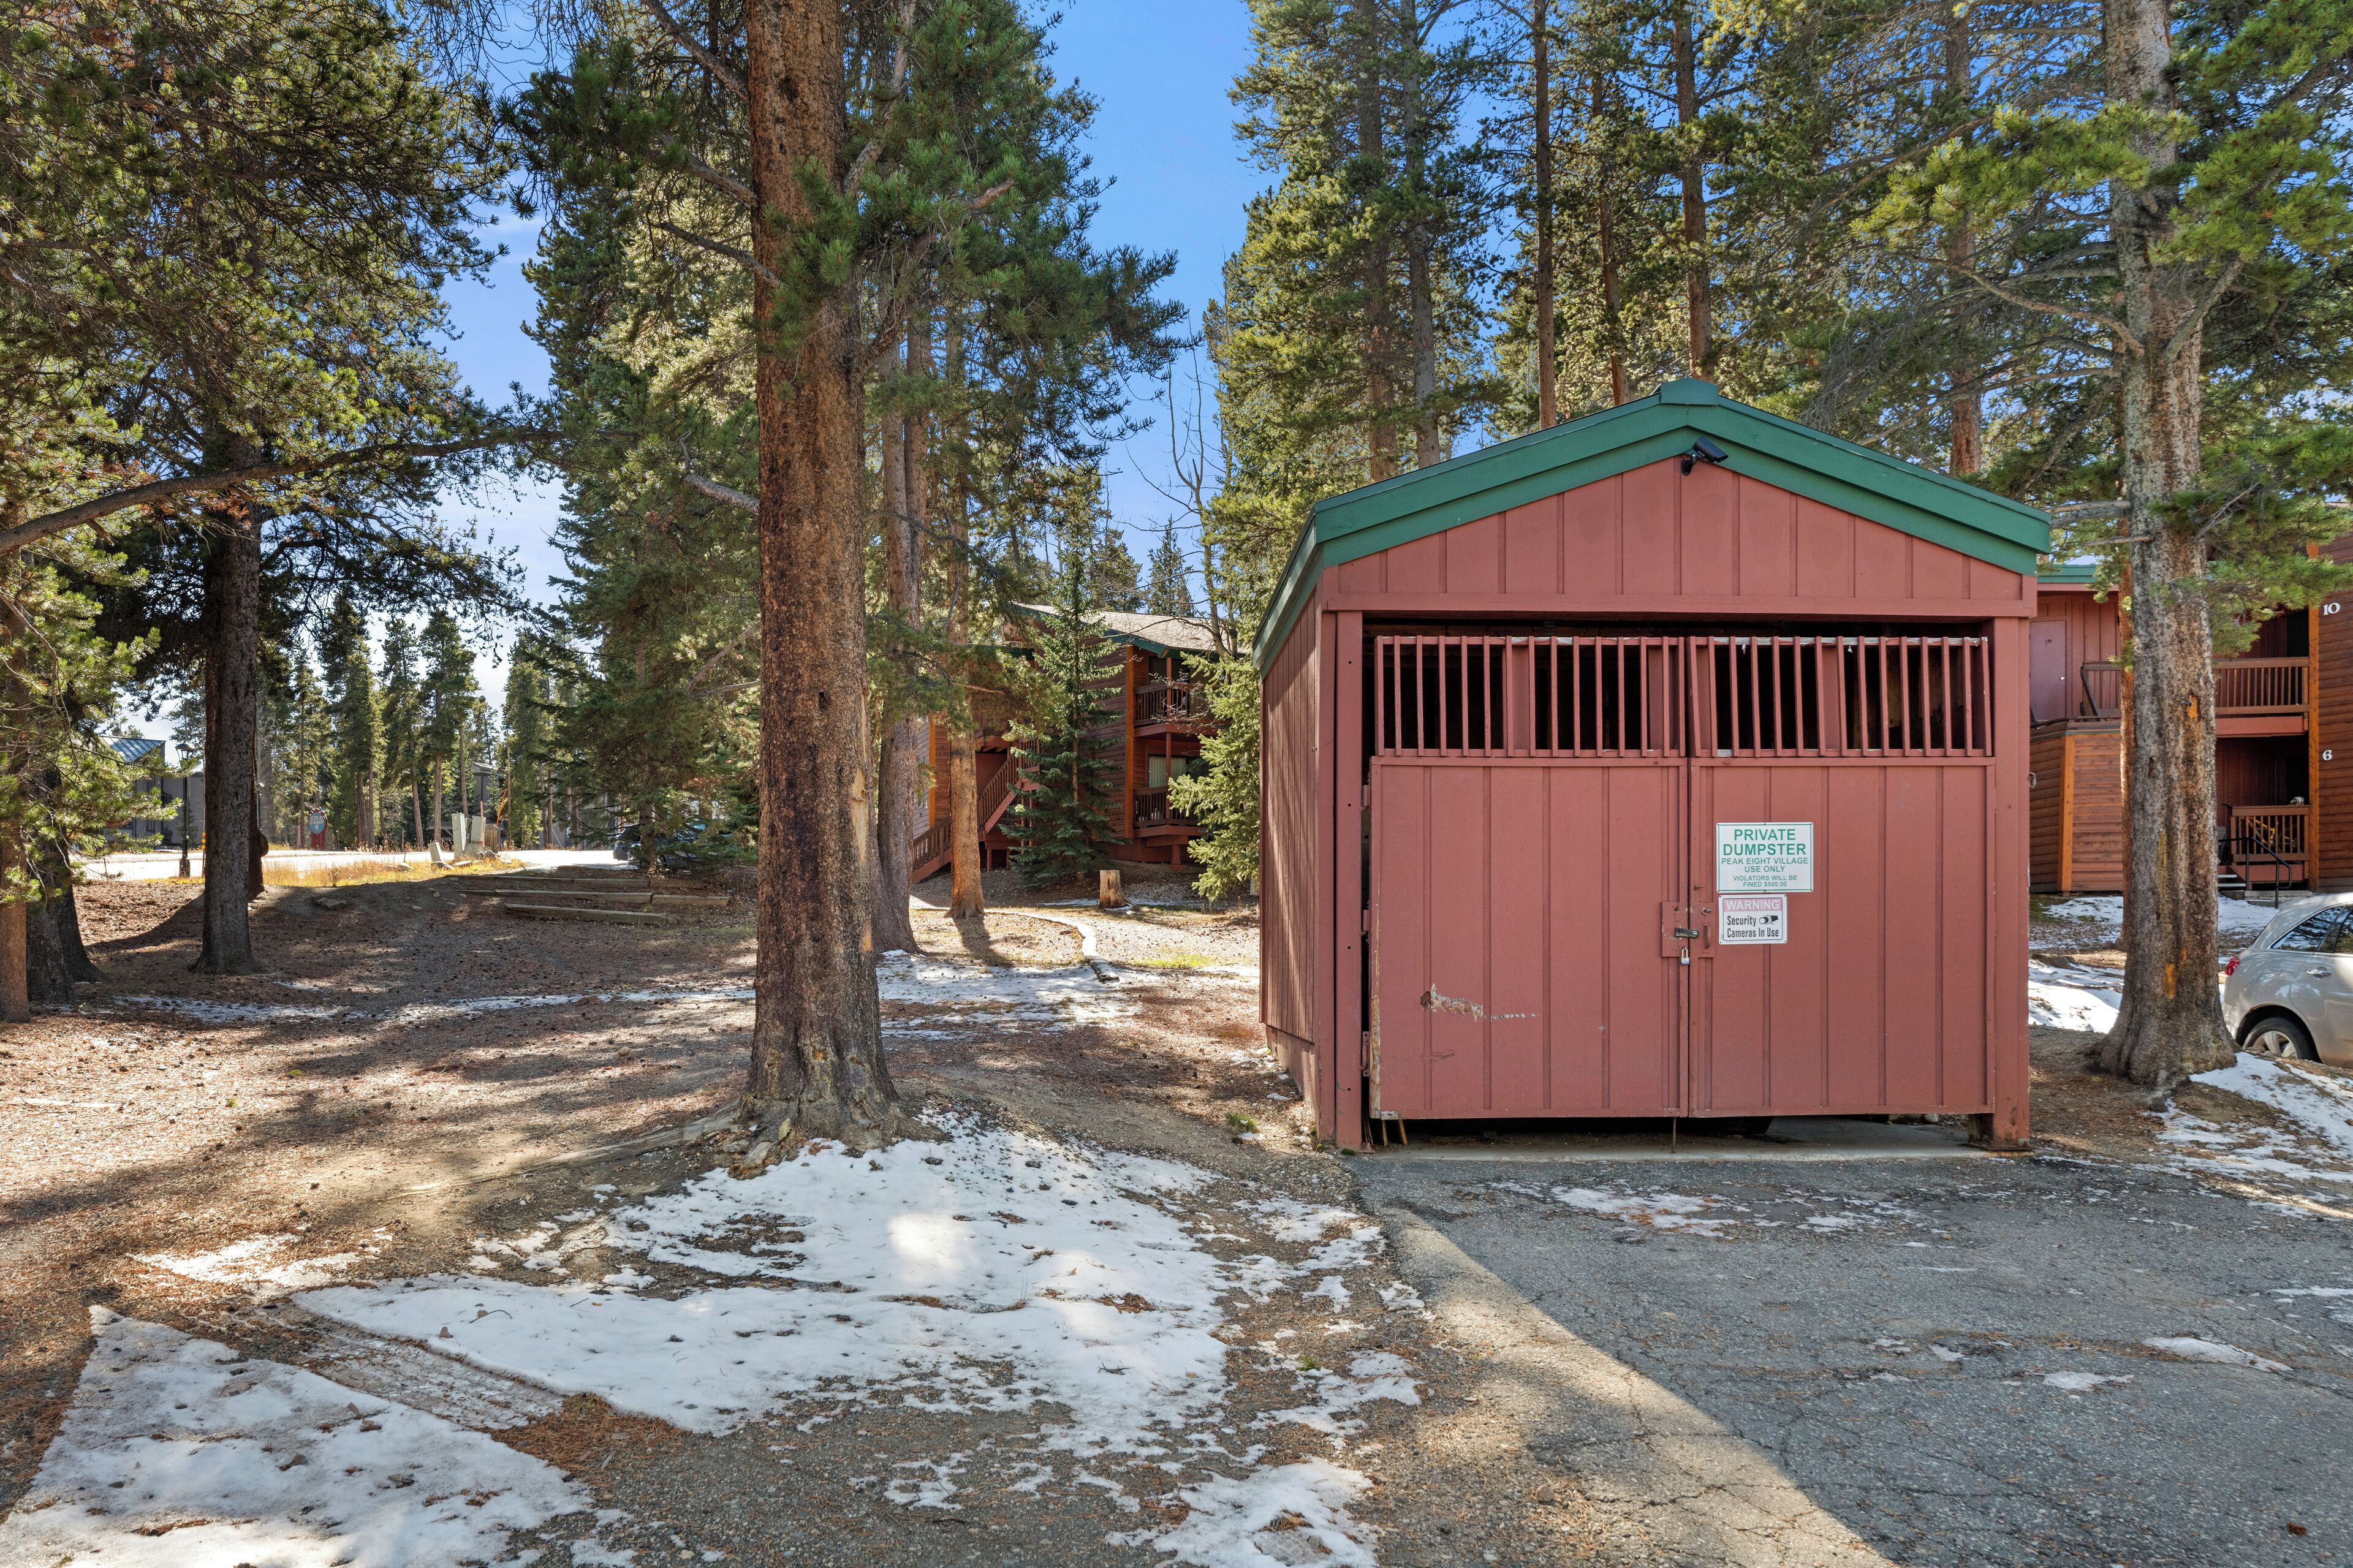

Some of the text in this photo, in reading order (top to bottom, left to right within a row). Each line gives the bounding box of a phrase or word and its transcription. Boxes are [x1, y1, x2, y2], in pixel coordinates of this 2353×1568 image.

[2323, 602, 2341, 615] 10
[2322, 749, 2332, 760] 6
[1734, 828, 1796, 841] PRIVATE
[1723, 843, 1806, 855] DUMPSTER
[1726, 900, 1780, 911] WARNING
[1727, 915, 1757, 927] Security
[1727, 928, 1756, 938] Cameras
[1759, 928, 1765, 937] In
[1767, 928, 1779, 937] Use
